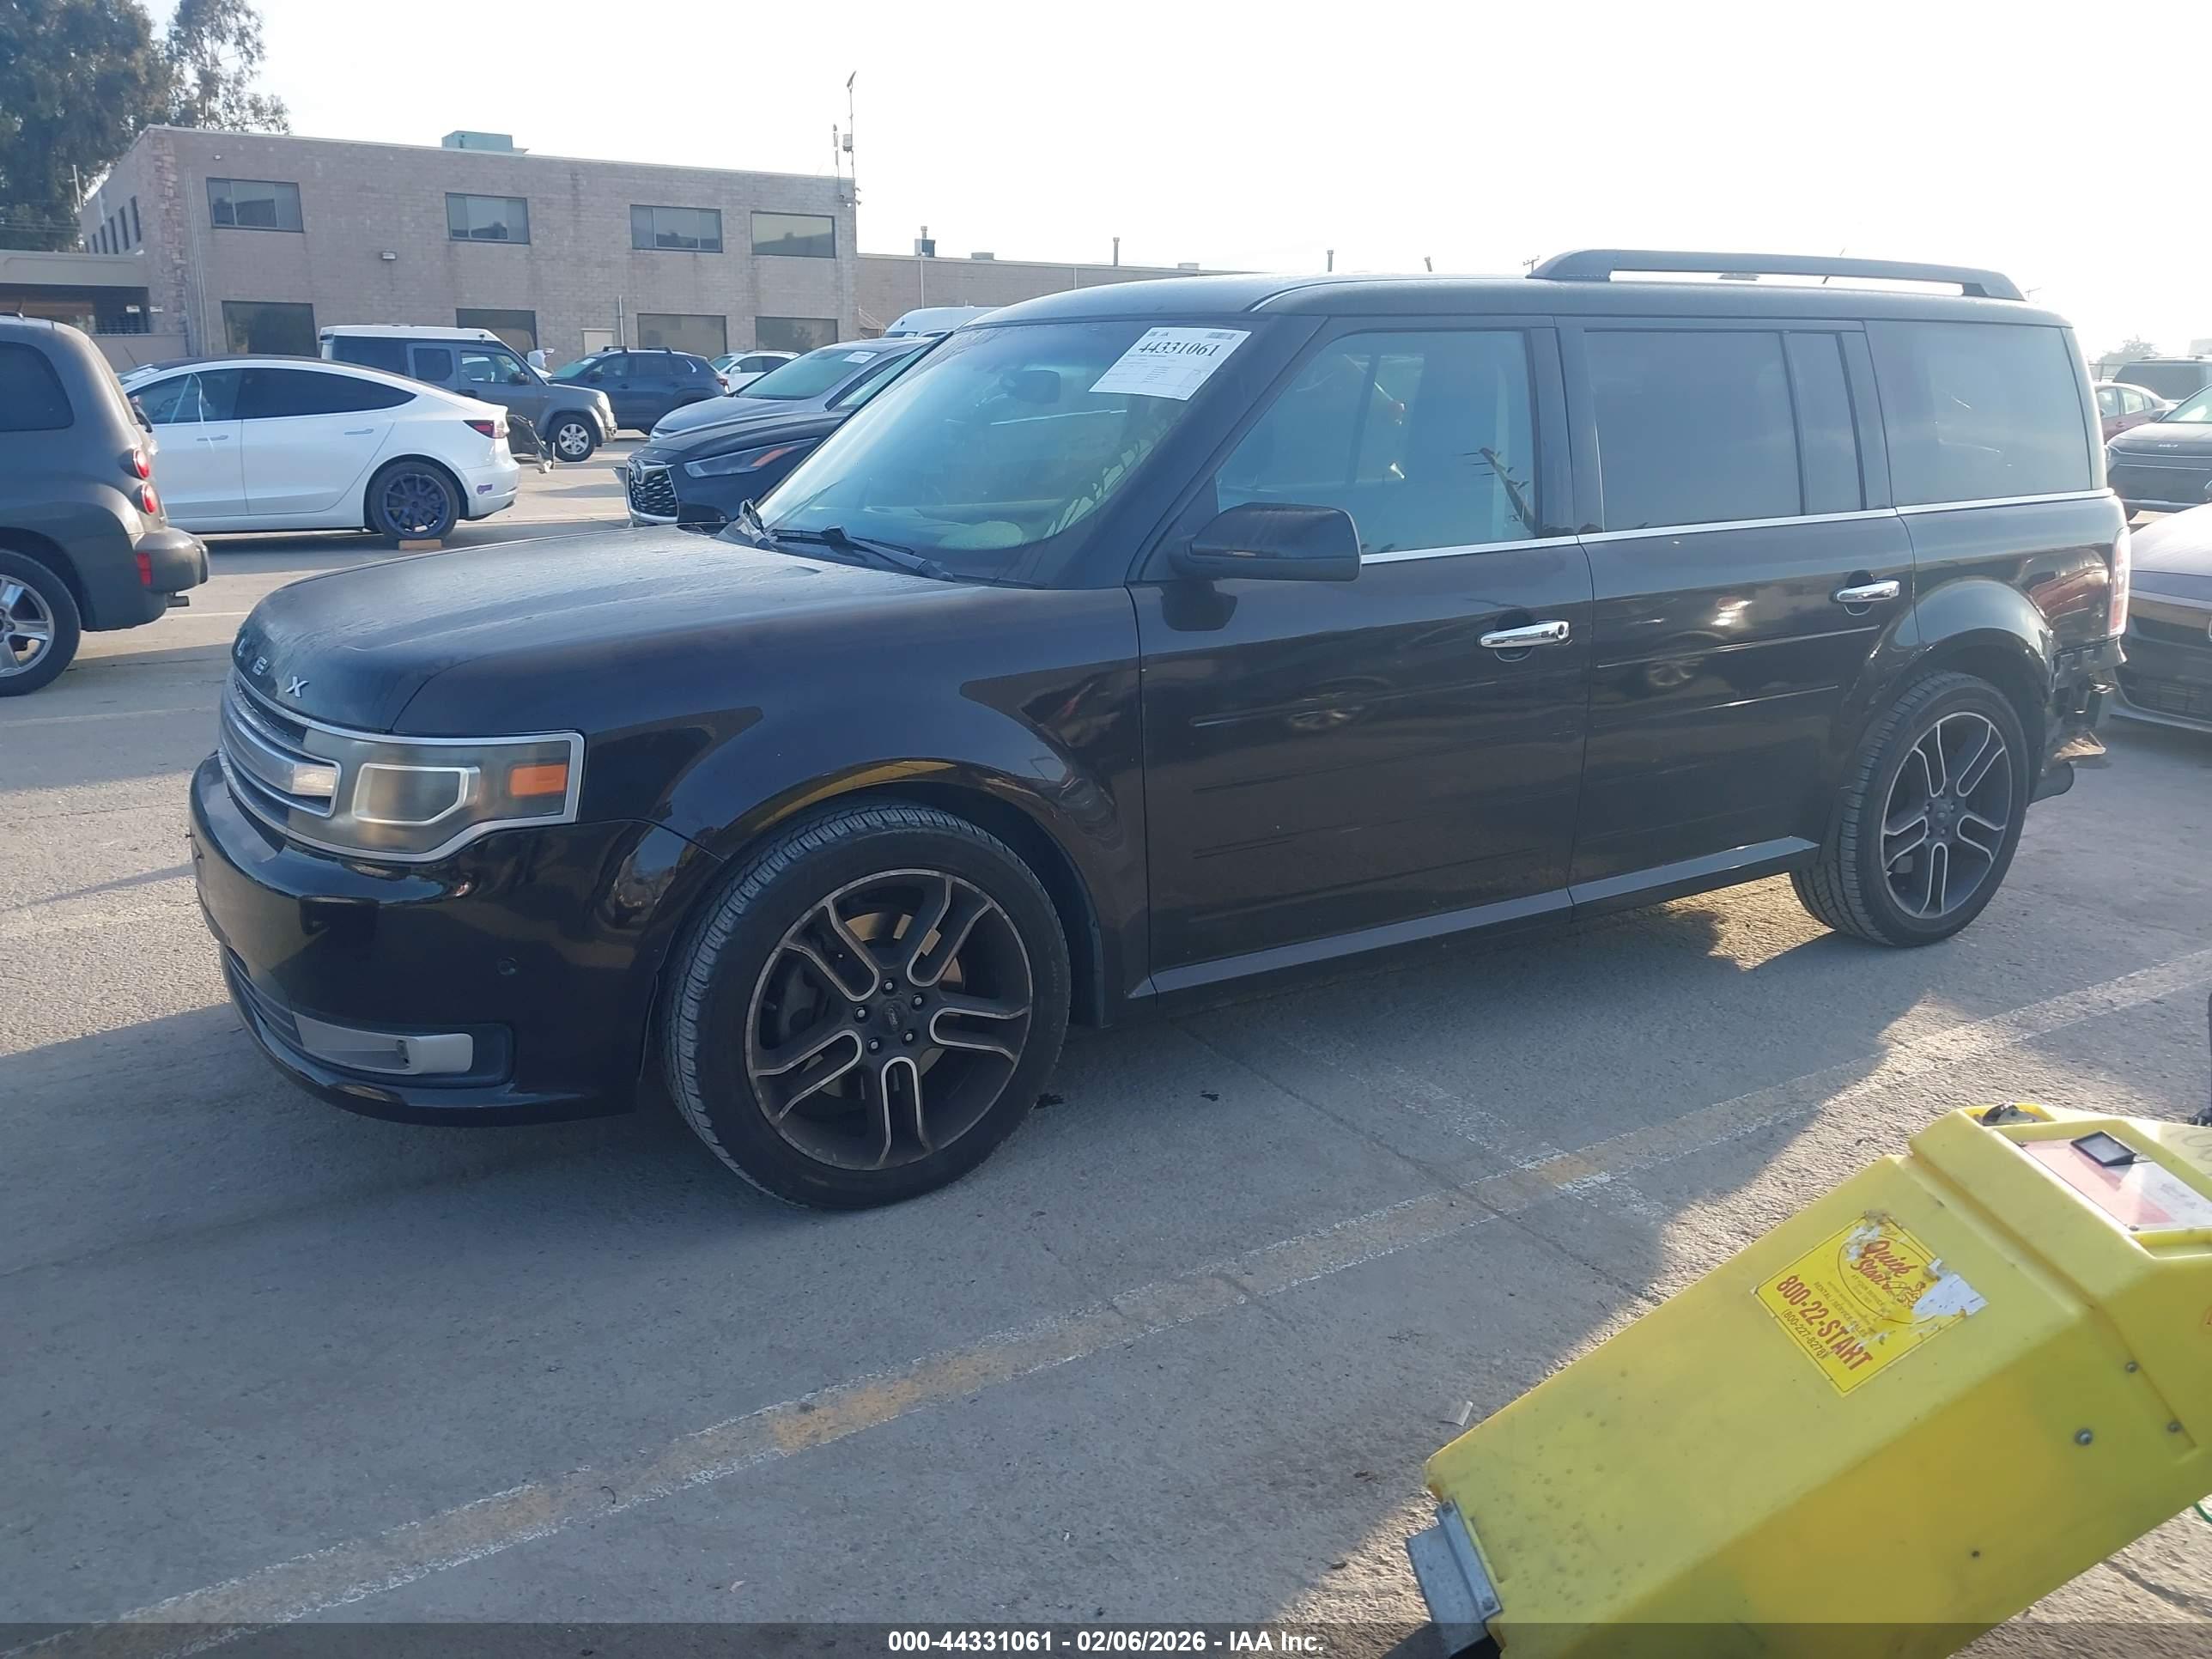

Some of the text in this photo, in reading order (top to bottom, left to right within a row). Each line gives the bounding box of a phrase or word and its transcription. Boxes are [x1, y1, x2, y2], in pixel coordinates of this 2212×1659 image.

[1138, 341, 1222, 357] 44331061
[235, 638, 310, 698] LEX
[1850, 1259, 1891, 1285] Start
[1861, 1240, 1918, 1278] Quick
[1776, 1274, 1874, 1370] 800-22-START
